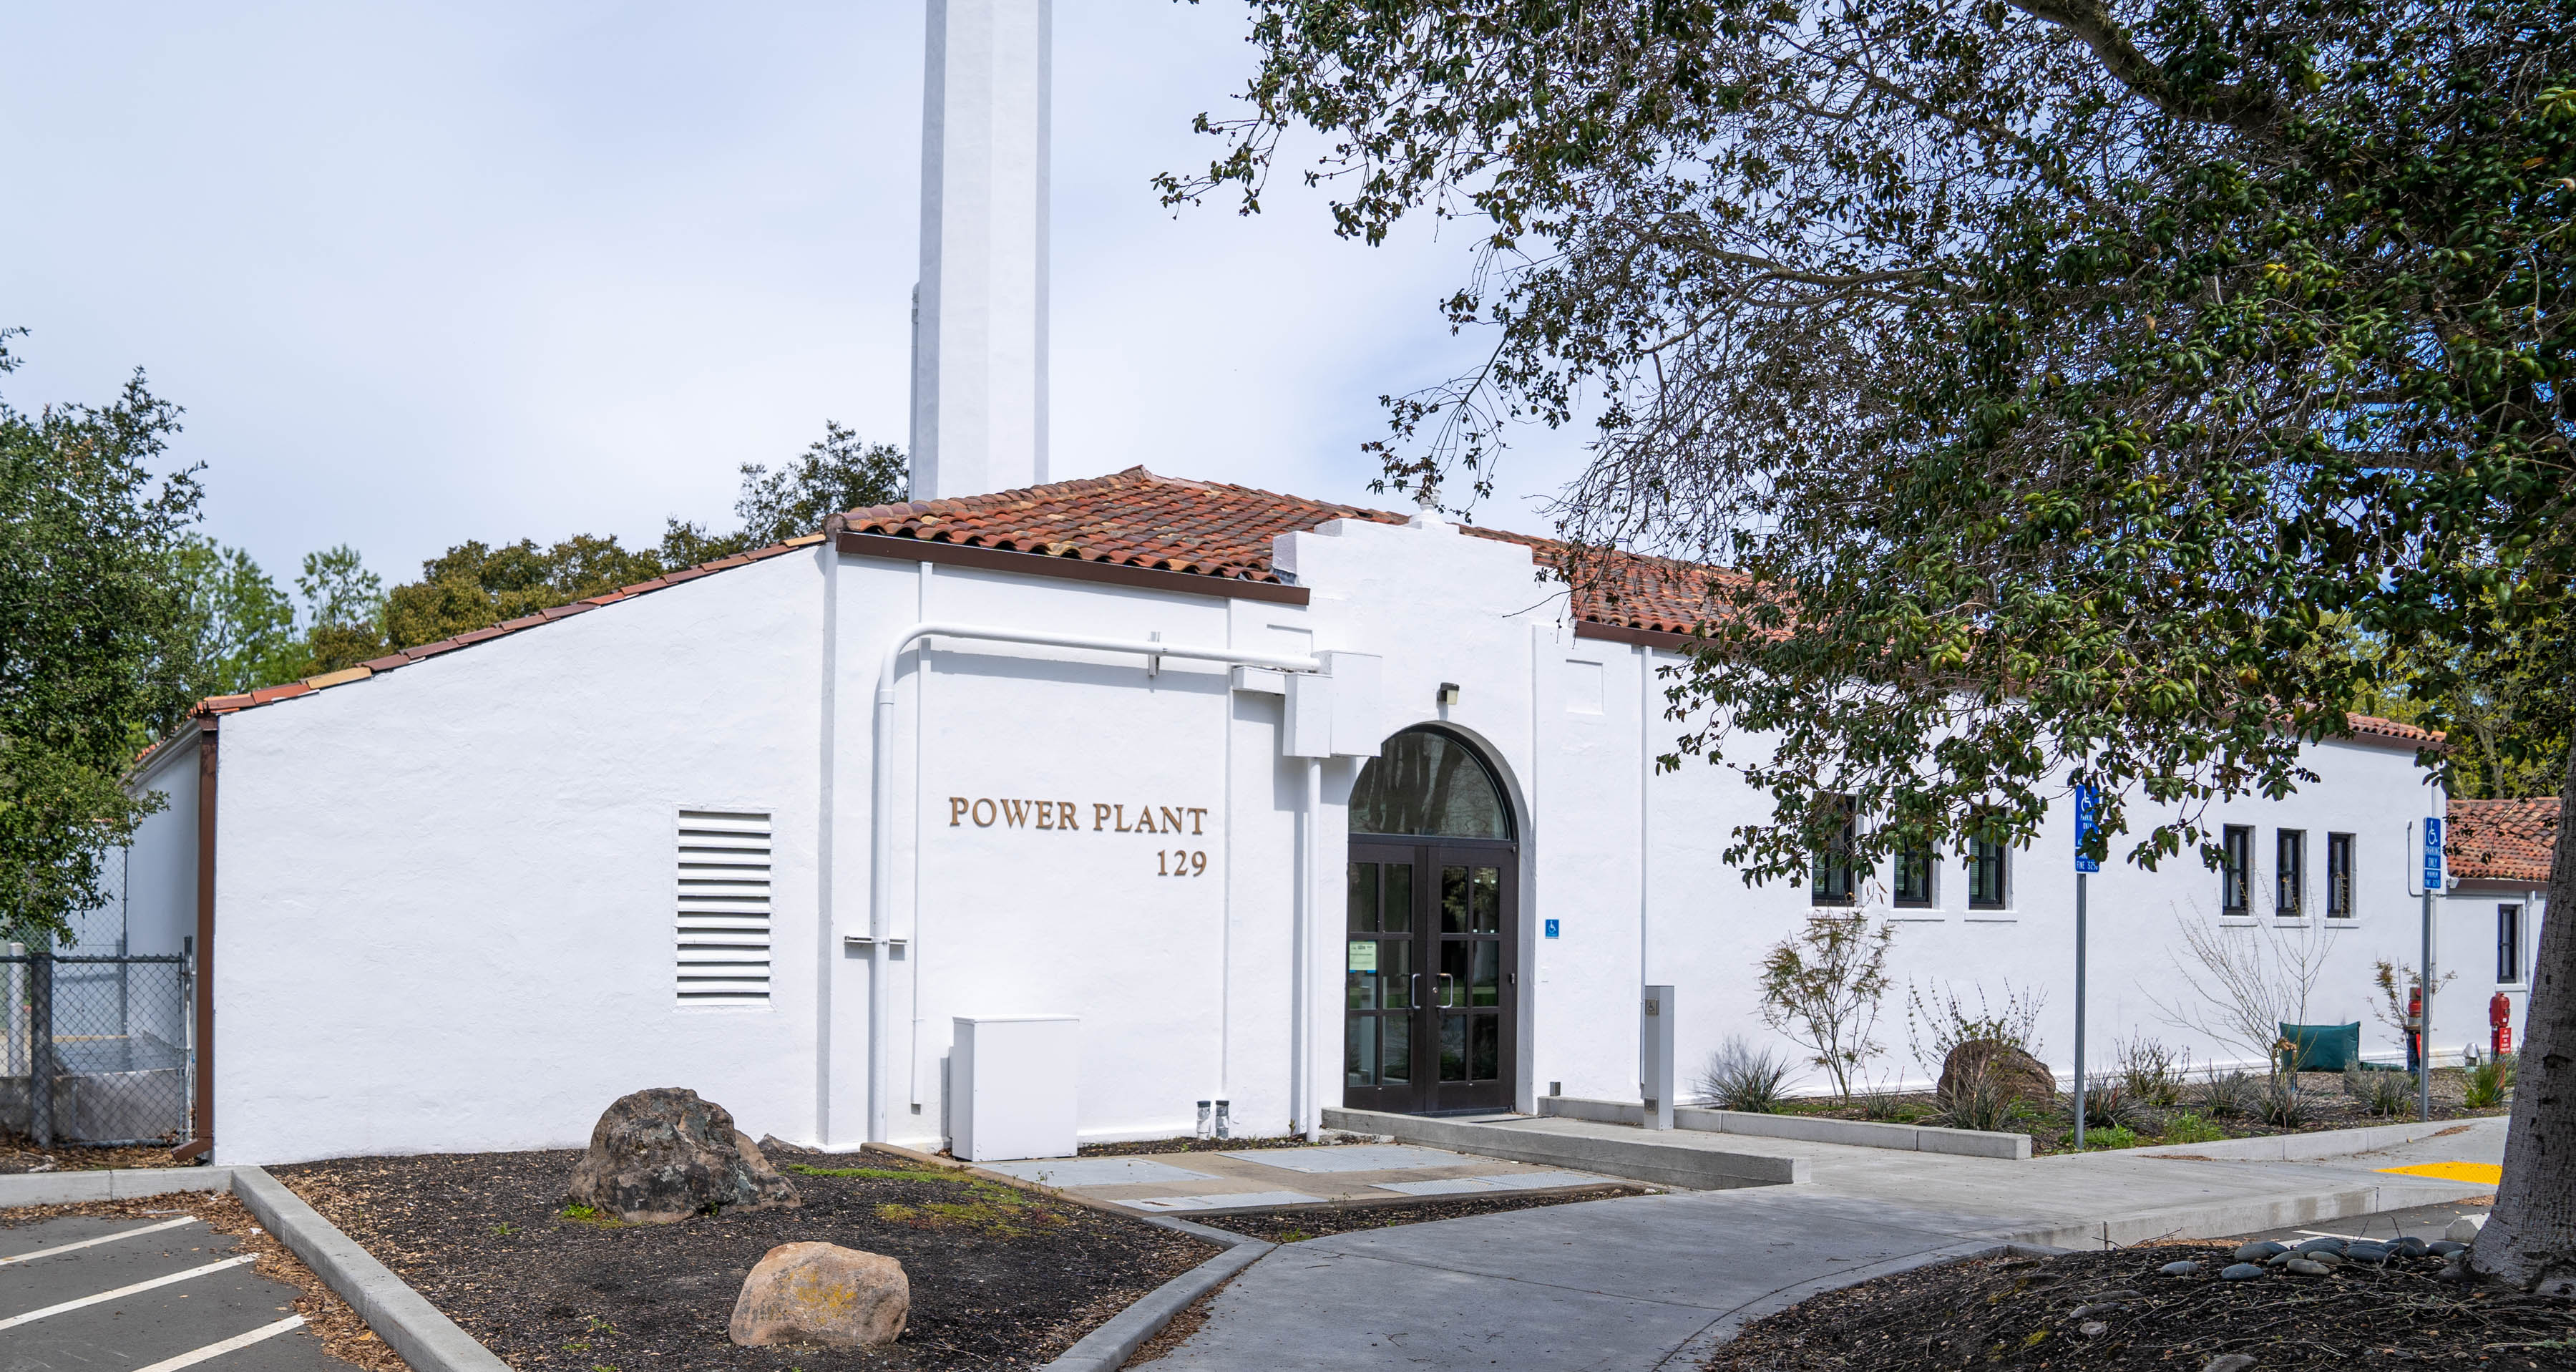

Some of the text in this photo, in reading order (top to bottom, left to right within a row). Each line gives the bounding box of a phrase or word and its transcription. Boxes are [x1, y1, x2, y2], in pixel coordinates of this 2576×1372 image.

[950, 797, 1208, 835] POWER PLANT
[1158, 850, 1206, 877] 129
